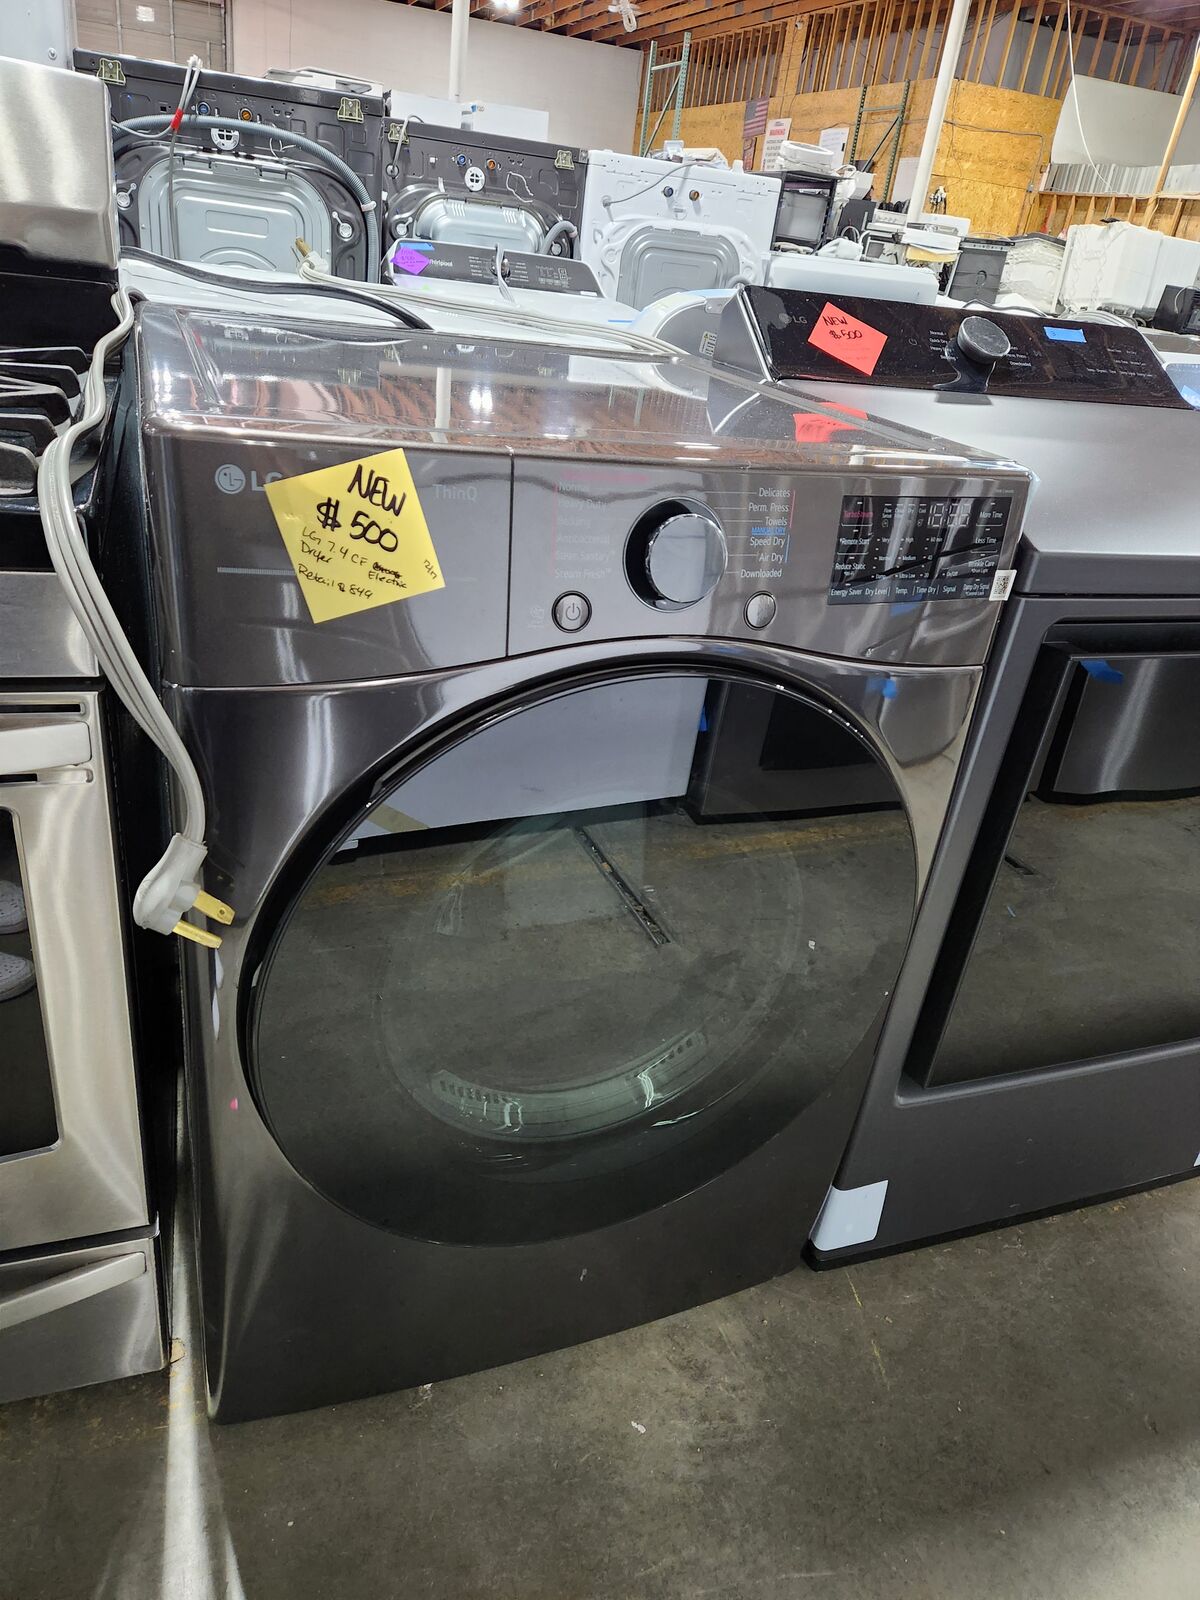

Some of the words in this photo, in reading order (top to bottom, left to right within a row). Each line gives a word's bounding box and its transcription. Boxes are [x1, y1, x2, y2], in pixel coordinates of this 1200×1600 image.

[429, 258, 453, 267] hirlpool
[793, 315, 807, 324] LG
[822, 314, 849, 327] NEW
[347, 464, 407, 517] NEW
[433, 484, 479, 502] ThinQ
[759, 488, 791, 497] Delicates
[749, 502, 768, 512] Perm.
[770, 502, 789, 512] Press
[765, 516, 787, 526] Towels
[301, 527, 322, 546] LG
[328, 540, 348, 559] 7.4
[352, 552, 368, 566] CF
[749, 537, 772, 548] Speed
[773, 537, 786, 548] Dry
[759, 553, 770, 562] Air
[771, 553, 784, 564] Dry
[300, 539, 333, 564] Dryer
[368, 570, 407, 589] Electric
[298, 563, 334, 587] Retail
[741, 569, 782, 578] Downloaded
[831, 588, 848, 598] Energy
[848, 588, 863, 596] Saver
[865, 588, 874, 597] Dry
[875, 587, 888, 596] Level
[916, 586, 927, 594] Time
[928, 586, 937, 595] Dry
[942, 585, 957, 594] Signal
